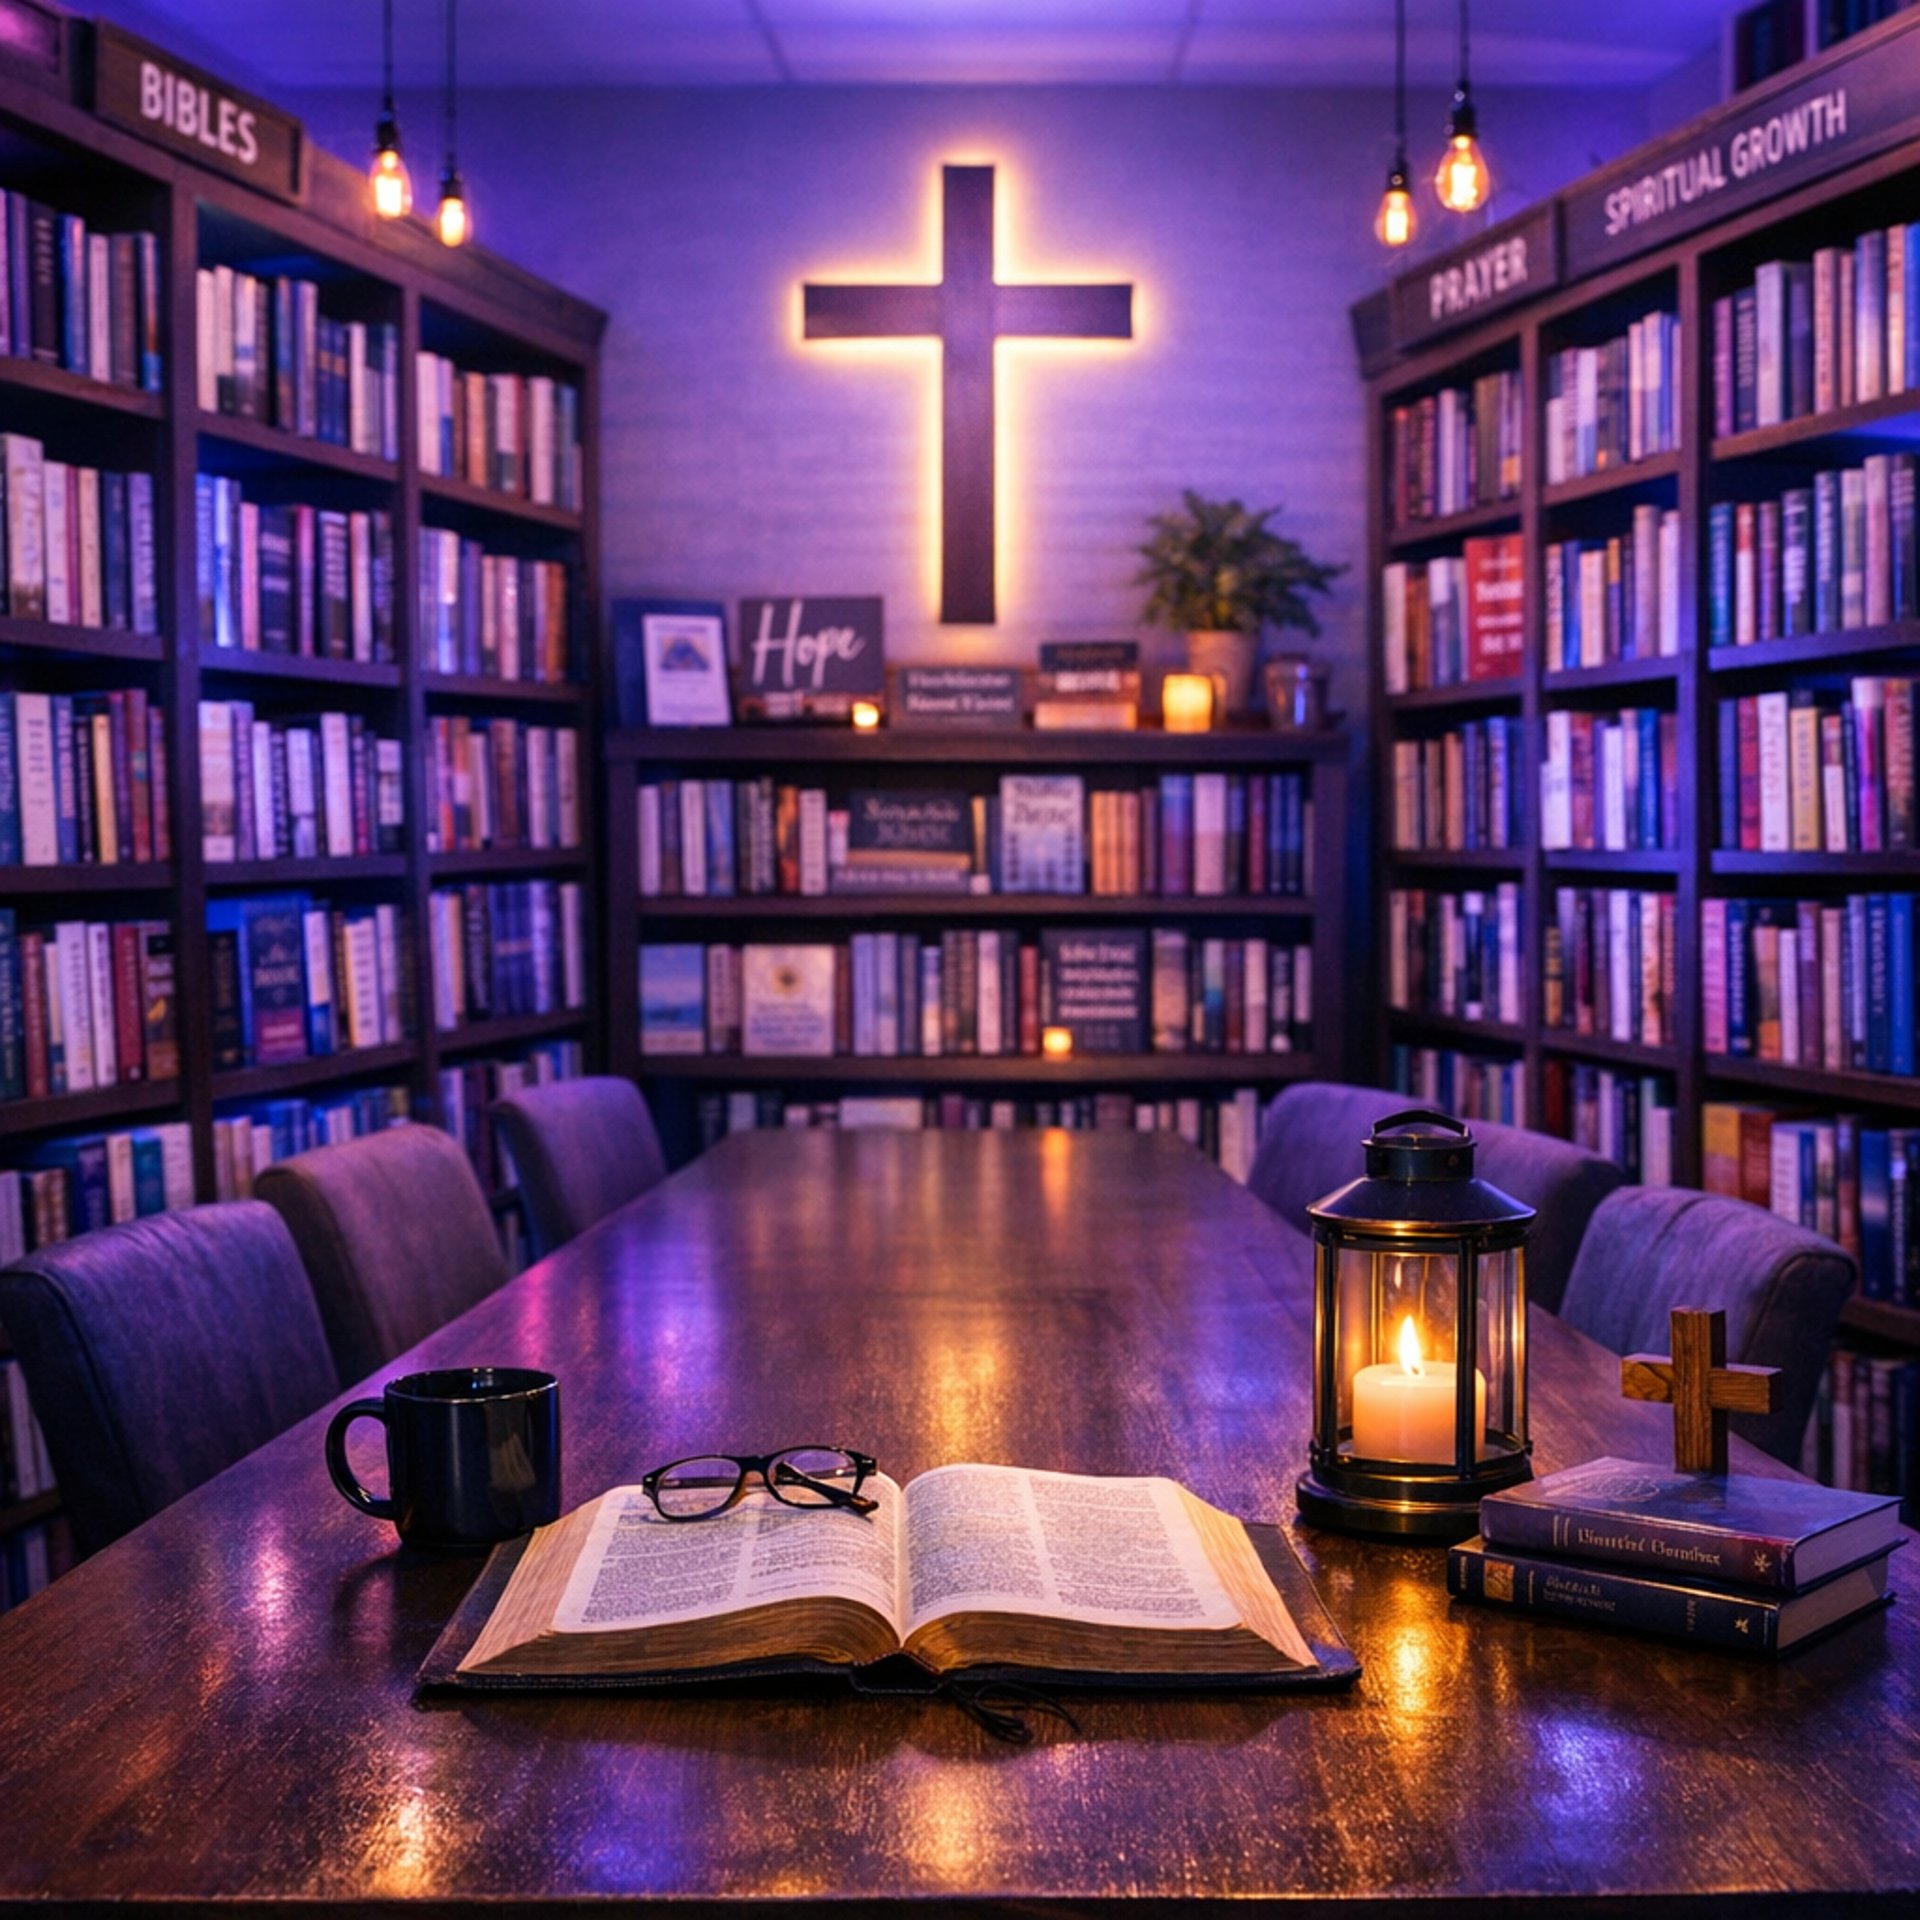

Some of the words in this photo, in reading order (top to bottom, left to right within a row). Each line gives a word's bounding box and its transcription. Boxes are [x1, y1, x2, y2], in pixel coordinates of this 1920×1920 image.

[140, 61, 258, 165] BIBLES
[1604, 146, 1727, 236] SPIRITUAL
[1730, 89, 1847, 179] GROWTH
[1430, 236, 1528, 321] PRAYER
[751, 598, 866, 688] Hope
